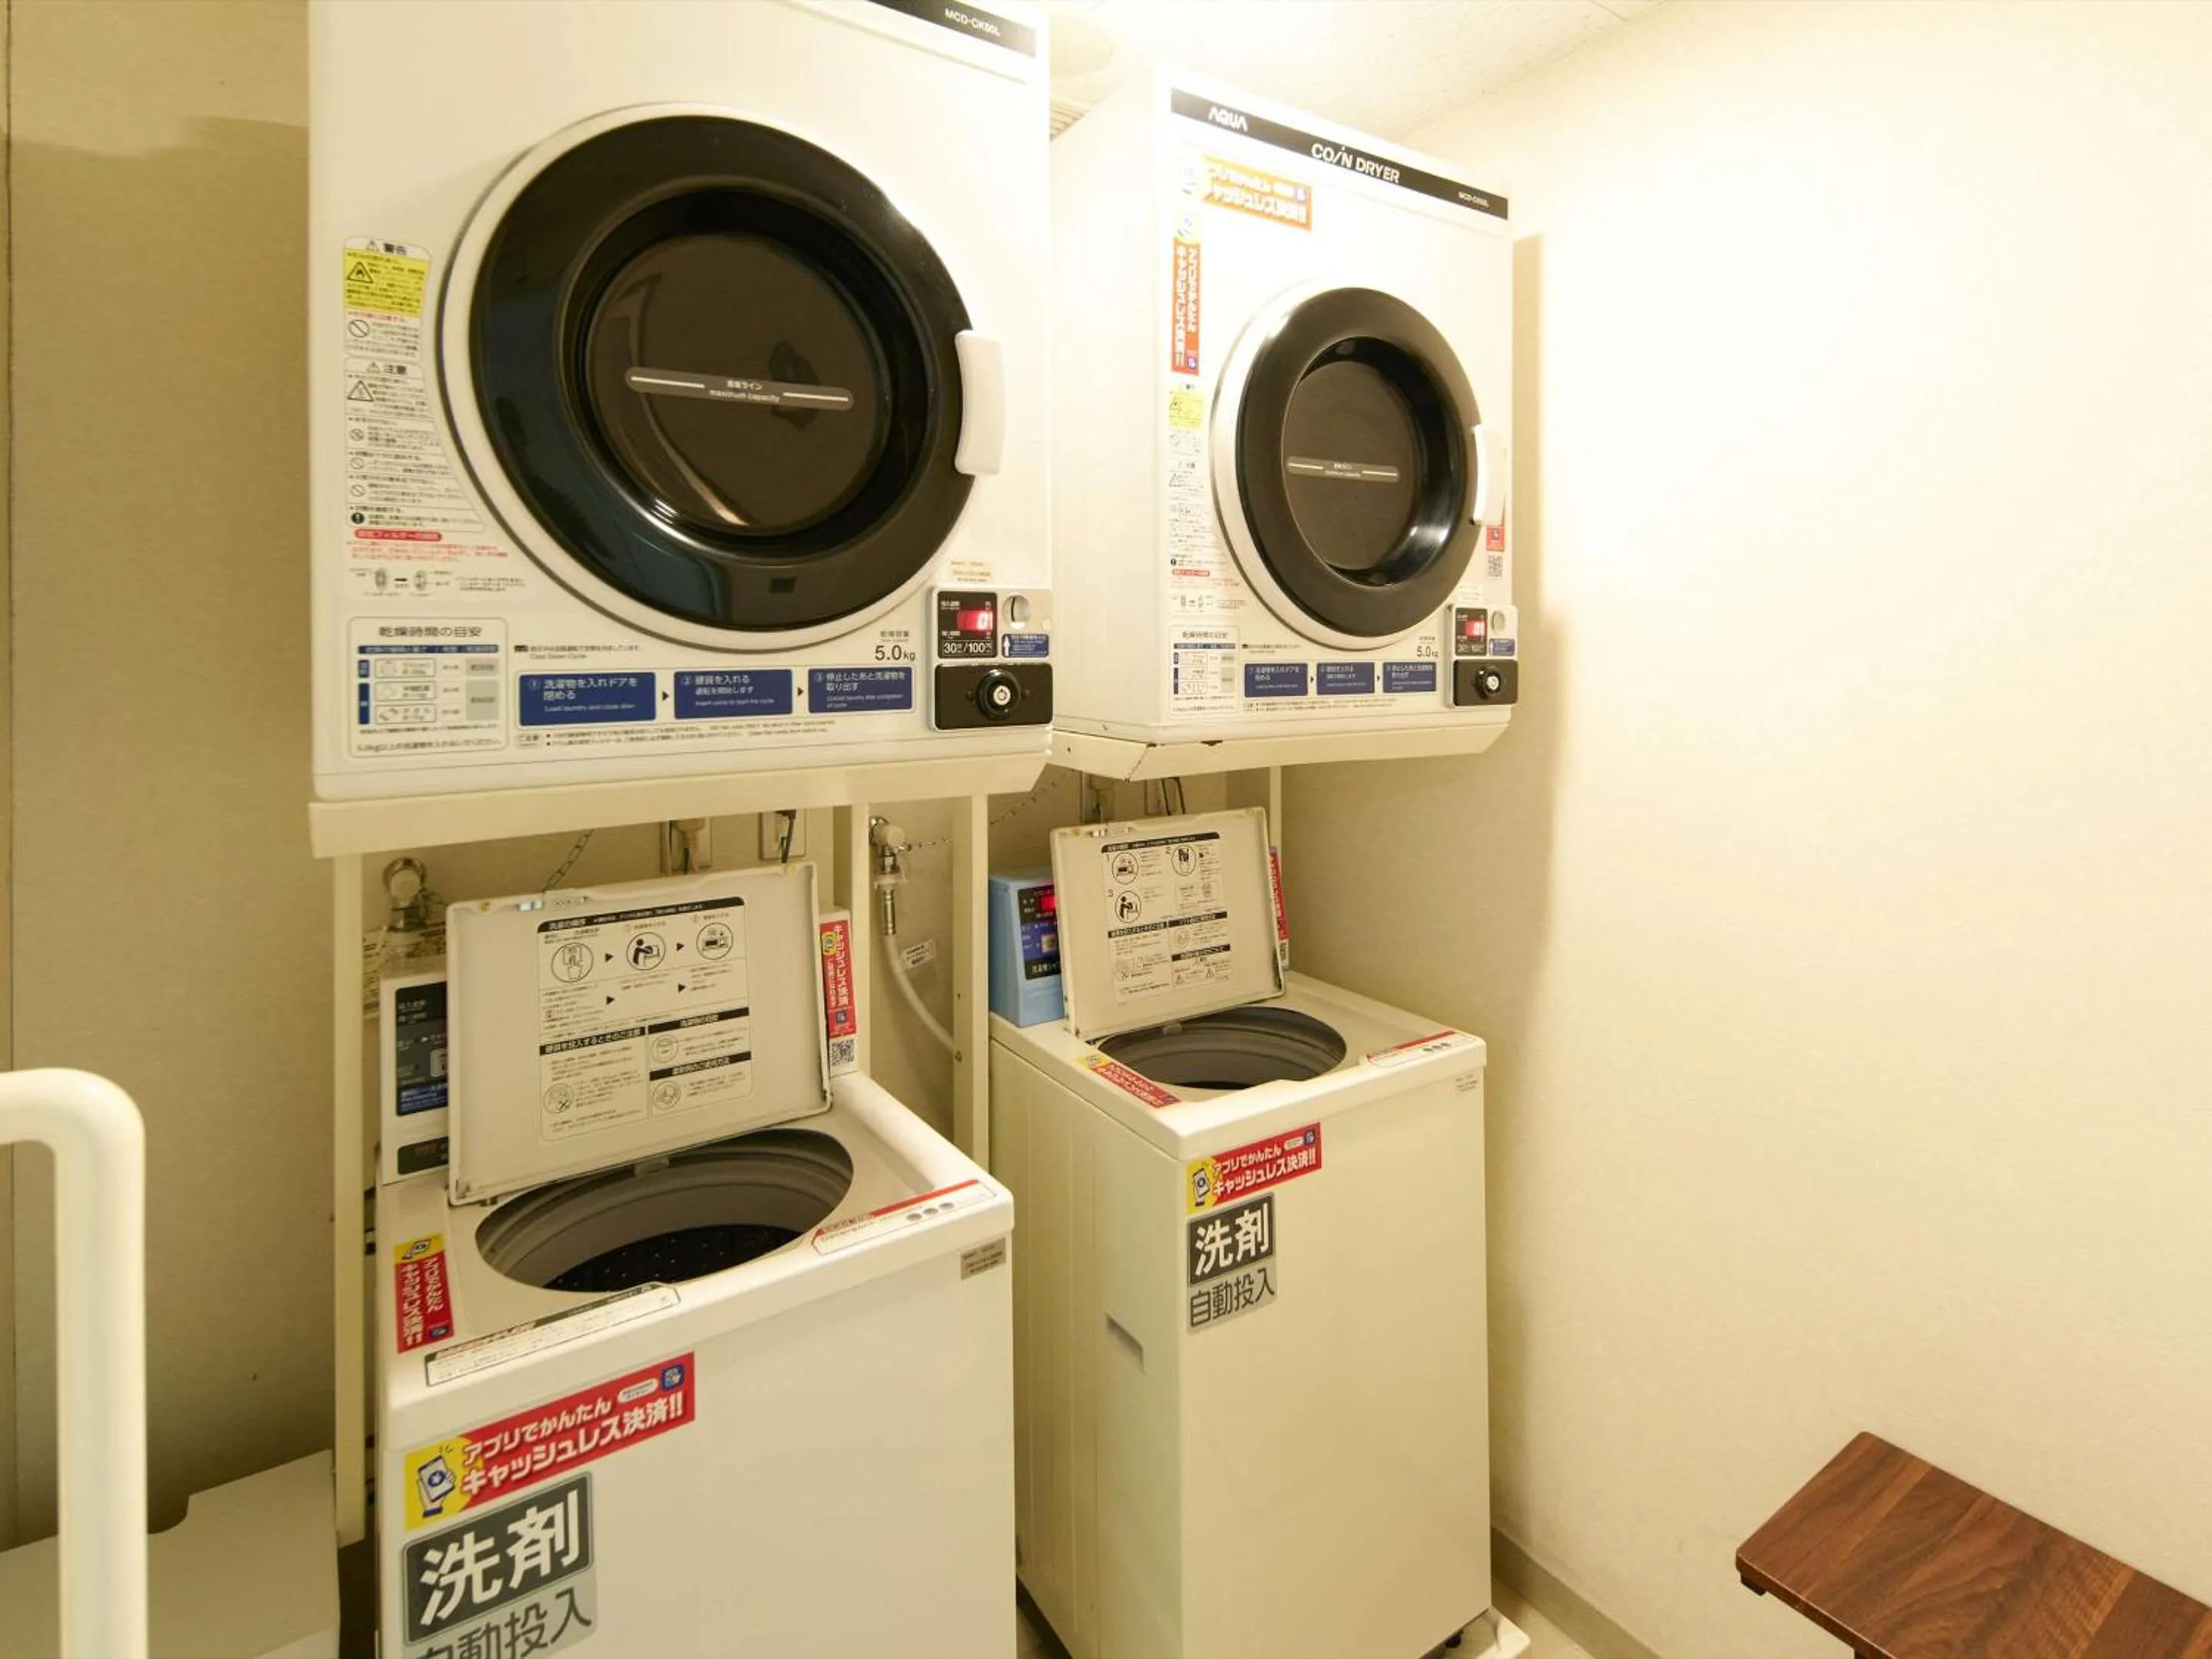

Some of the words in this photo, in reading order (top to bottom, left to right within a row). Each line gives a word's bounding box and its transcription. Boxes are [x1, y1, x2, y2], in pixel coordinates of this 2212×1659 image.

[1207, 106, 1249, 132] AQUA
[1355, 156, 1401, 184] DRYER
[874, 644, 916, 662] 5.0kg
[1214, 1144, 1283, 1176] アプリでかんたん
[1194, 1202, 1269, 1277] 洗剤
[1190, 1267, 1276, 1328] 自動投入
[462, 1397, 612, 1466] アプリでかんたん
[462, 1391, 684, 1495] キャッシュレス決済!!
[419, 1490, 581, 1627] 洗剤
